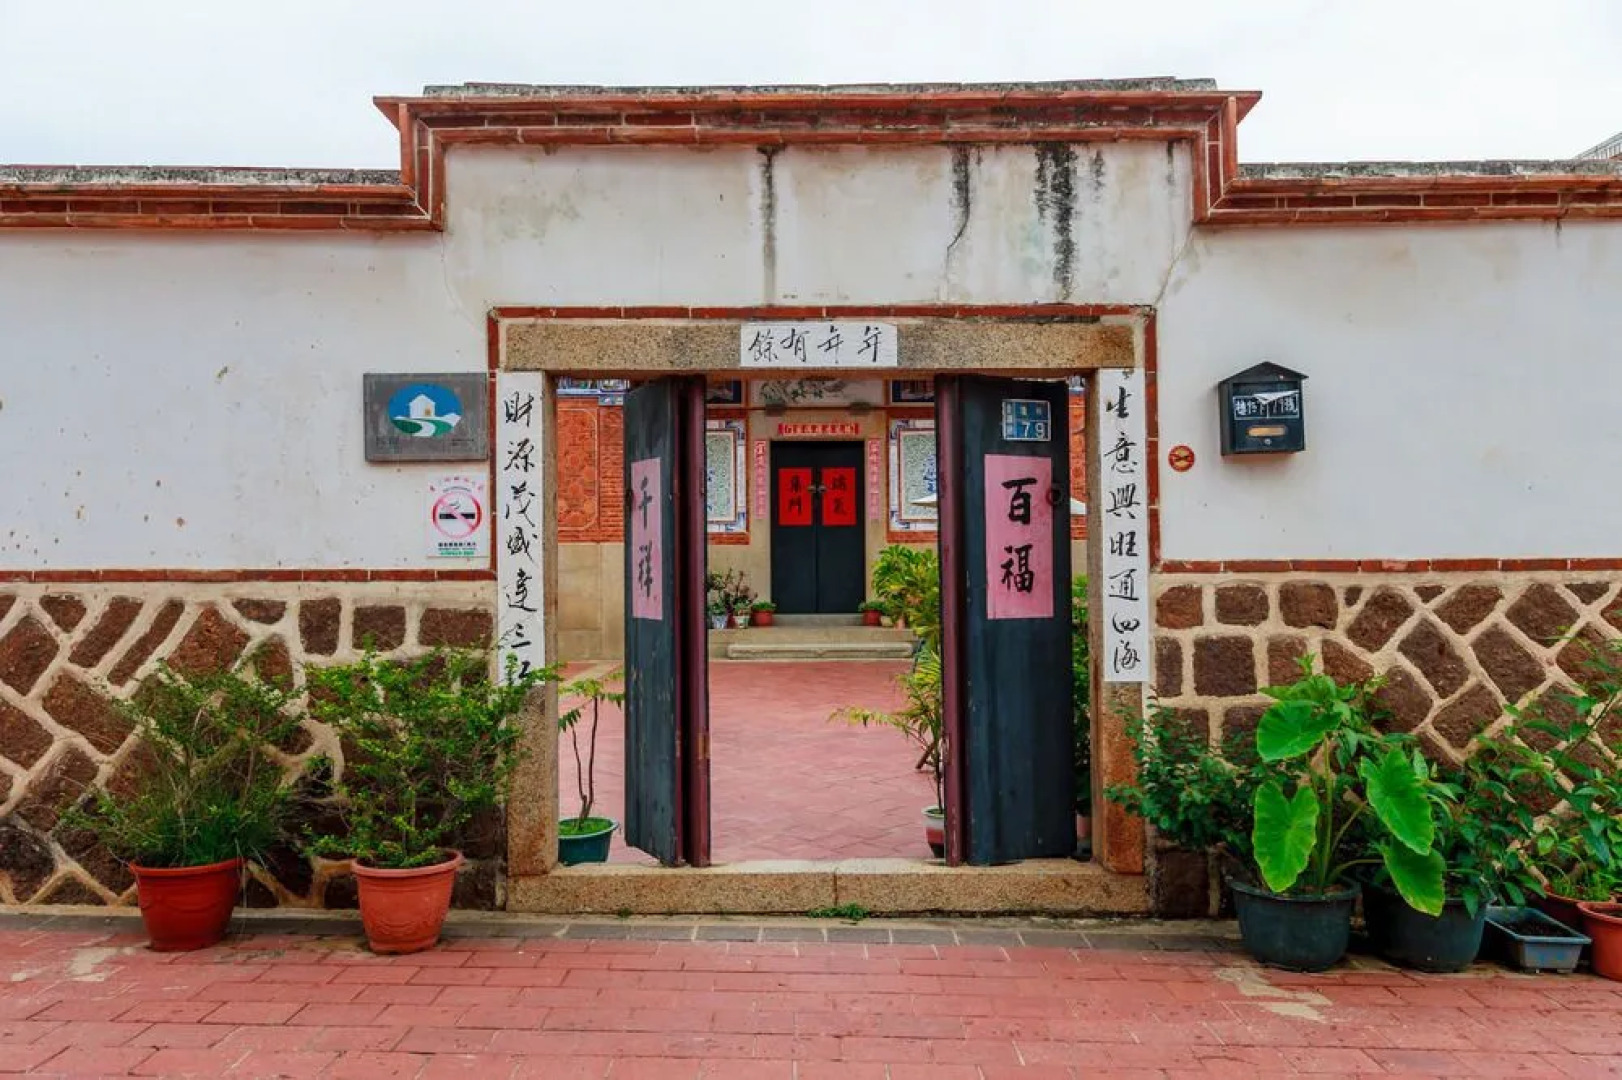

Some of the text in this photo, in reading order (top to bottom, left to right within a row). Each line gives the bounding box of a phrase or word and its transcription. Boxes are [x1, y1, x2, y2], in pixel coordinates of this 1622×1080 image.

[1021, 421, 1045, 440] 79
[637, 475, 653, 598] 千祥
[1000, 477, 1038, 594] 百福
[1102, 386, 1142, 674] 生意興旺通四海
